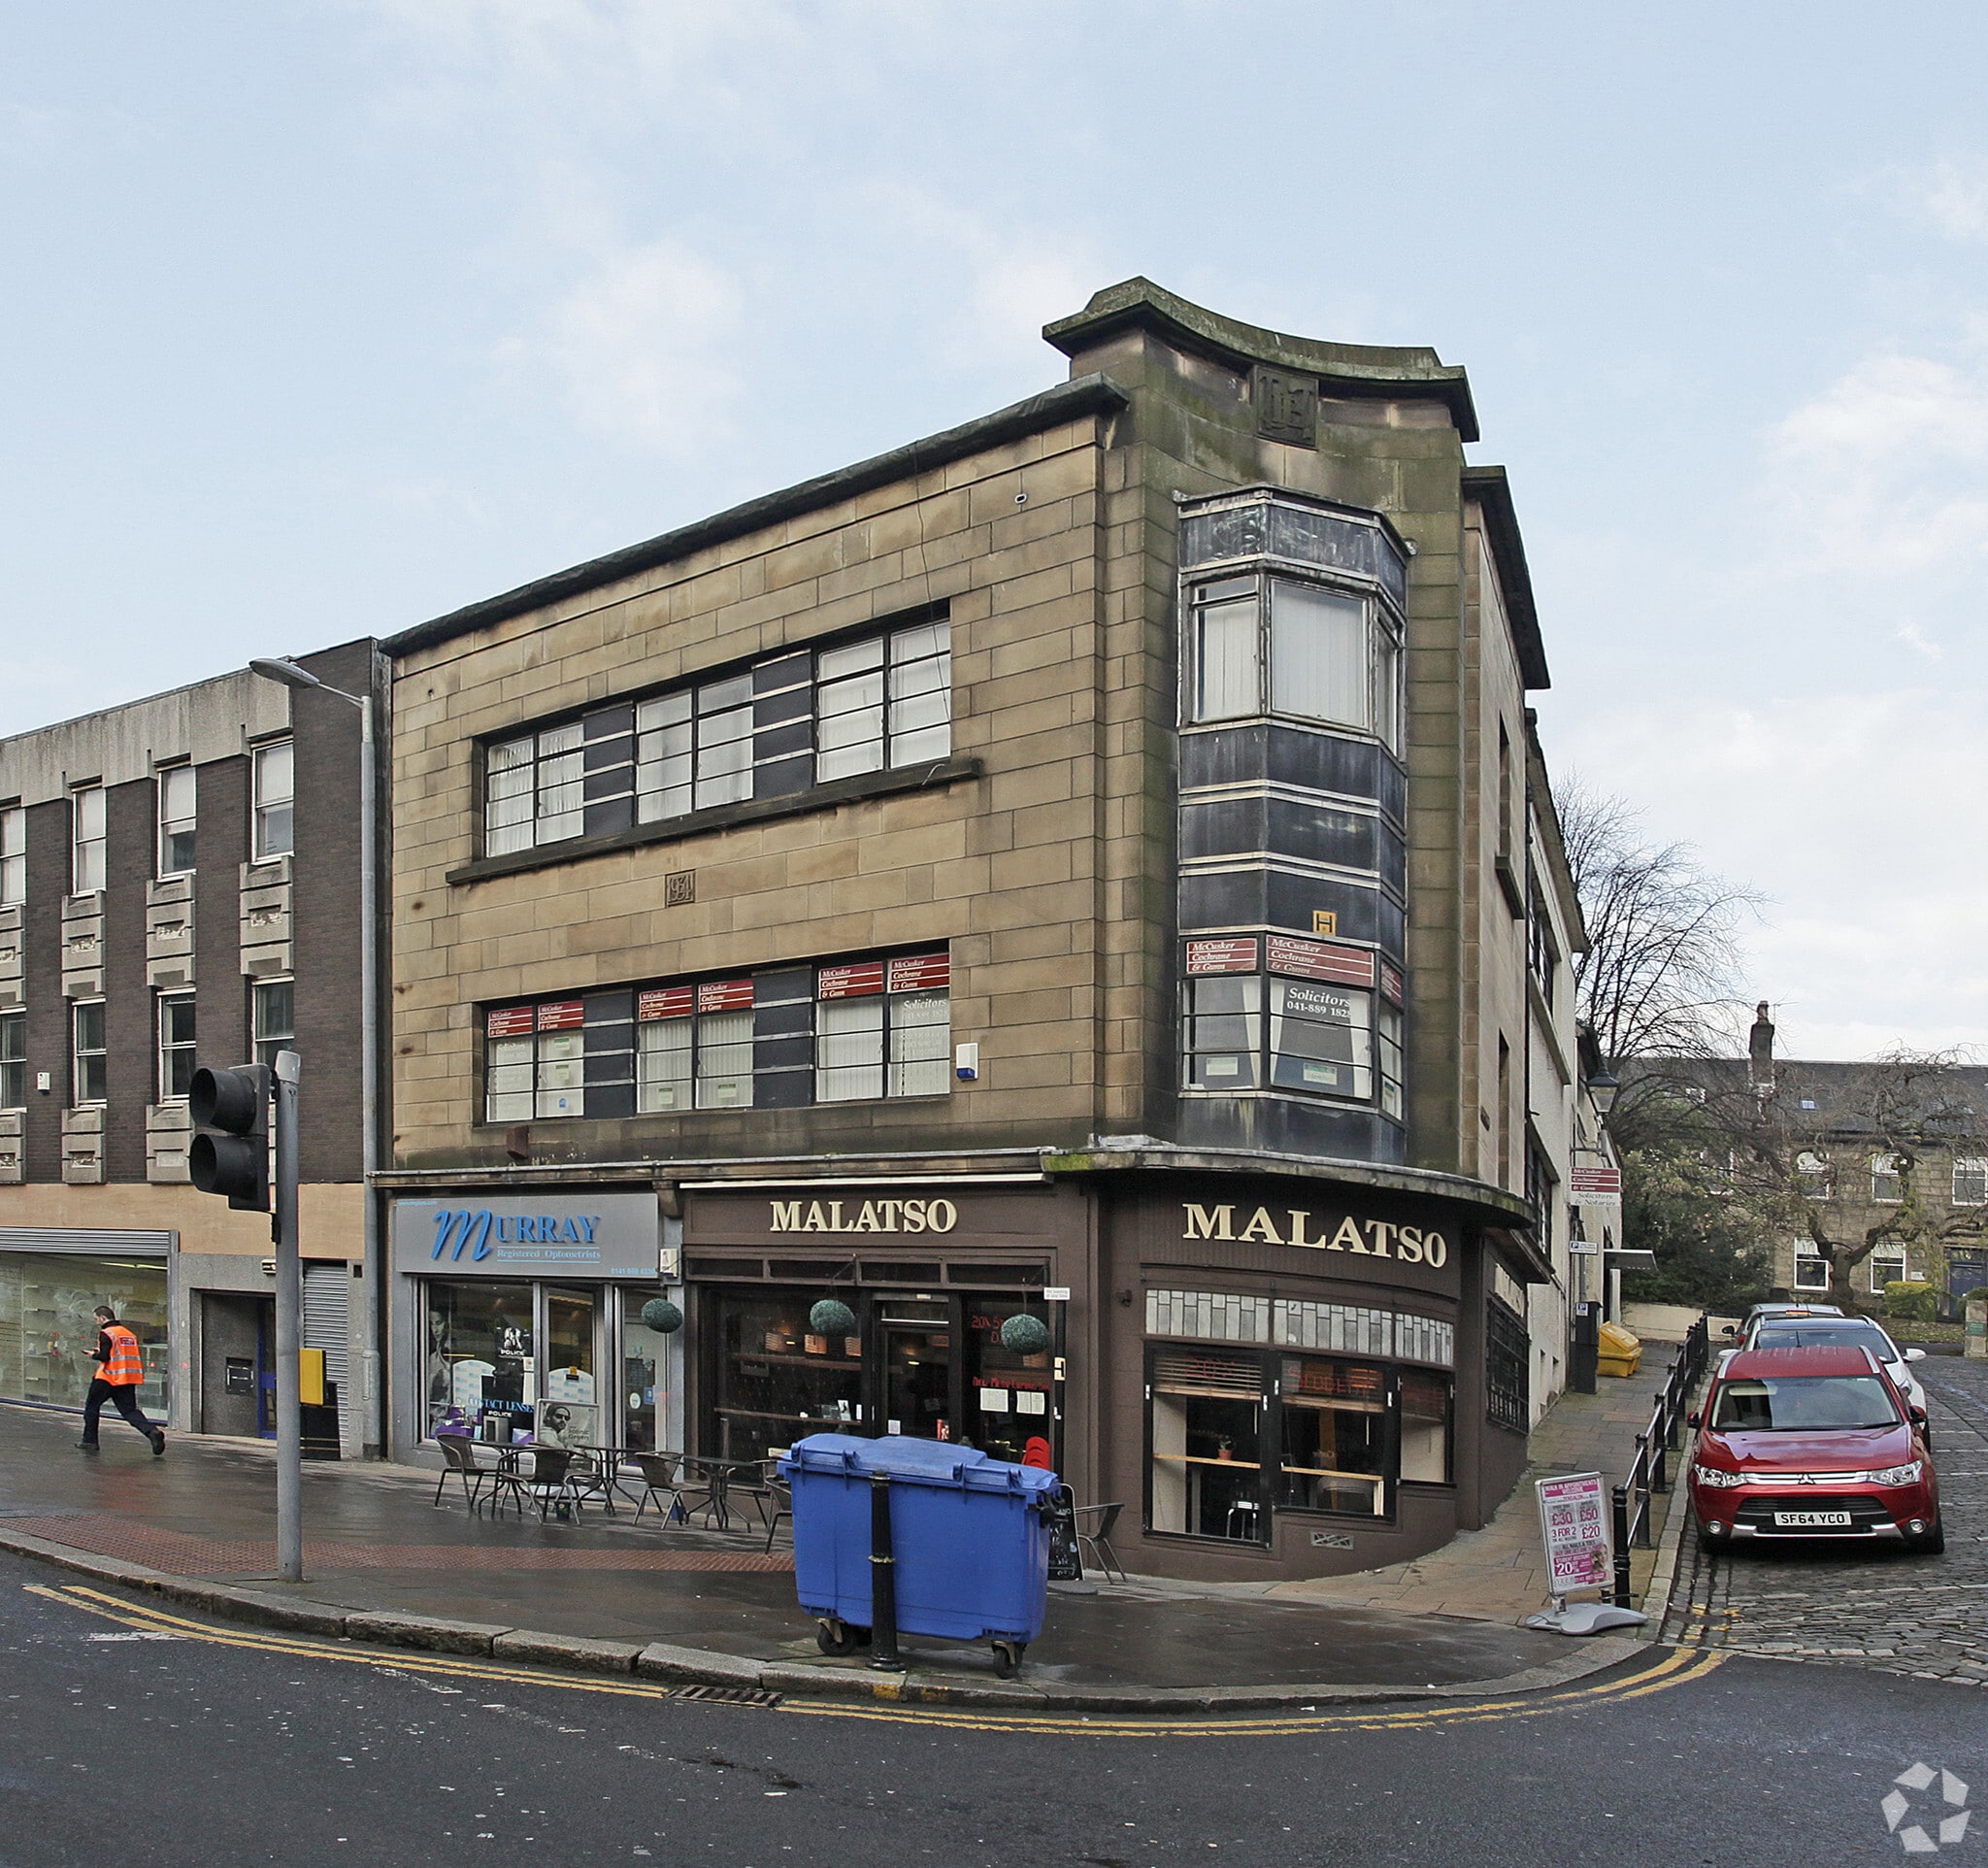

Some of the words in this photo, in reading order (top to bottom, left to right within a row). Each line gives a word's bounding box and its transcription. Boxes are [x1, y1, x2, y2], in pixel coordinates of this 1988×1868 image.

[1192, 941, 1236, 951] McCusker
[1271, 938, 1321, 953] McCusker
[1192, 951, 1231, 961] Cochrane
[1271, 951, 1316, 964] Cochrane
[893, 959, 925, 969] McCusker
[1191, 962, 1201, 971] &
[1202, 962, 1226, 971] Gunn
[1271, 961, 1281, 970] &
[1284, 962, 1310, 975] Gunn
[822, 968, 851, 978] McCusker
[892, 970, 922, 980] Cochrane
[821, 979, 849, 988] Cochrane
[1289, 986, 1352, 1008] Solicitors
[903, 998, 947, 1010] Solicitors
[1287, 1000, 1327, 1016] 041-889
[770, 1199, 958, 1234] MALATSO
[431, 1209, 601, 1261] MURRAY
[1182, 1203, 1447, 1269] MALATSO
[496, 1248, 541, 1259] Registered
[545, 1249, 601, 1260] Optometrists
[506, 1400, 535, 1414] LENSES
[1552, 1512, 1574, 1526] £30
[1579, 1507, 1599, 1522] £50
[1781, 1514, 1814, 1524] SF64
[1819, 1513, 1845, 1523] YCO
[1552, 1529, 1557, 1539] 3
[1558, 1527, 1571, 1537] FOR
[1572, 1526, 1577, 1535] 2
[1581, 1525, 1601, 1540] £20
